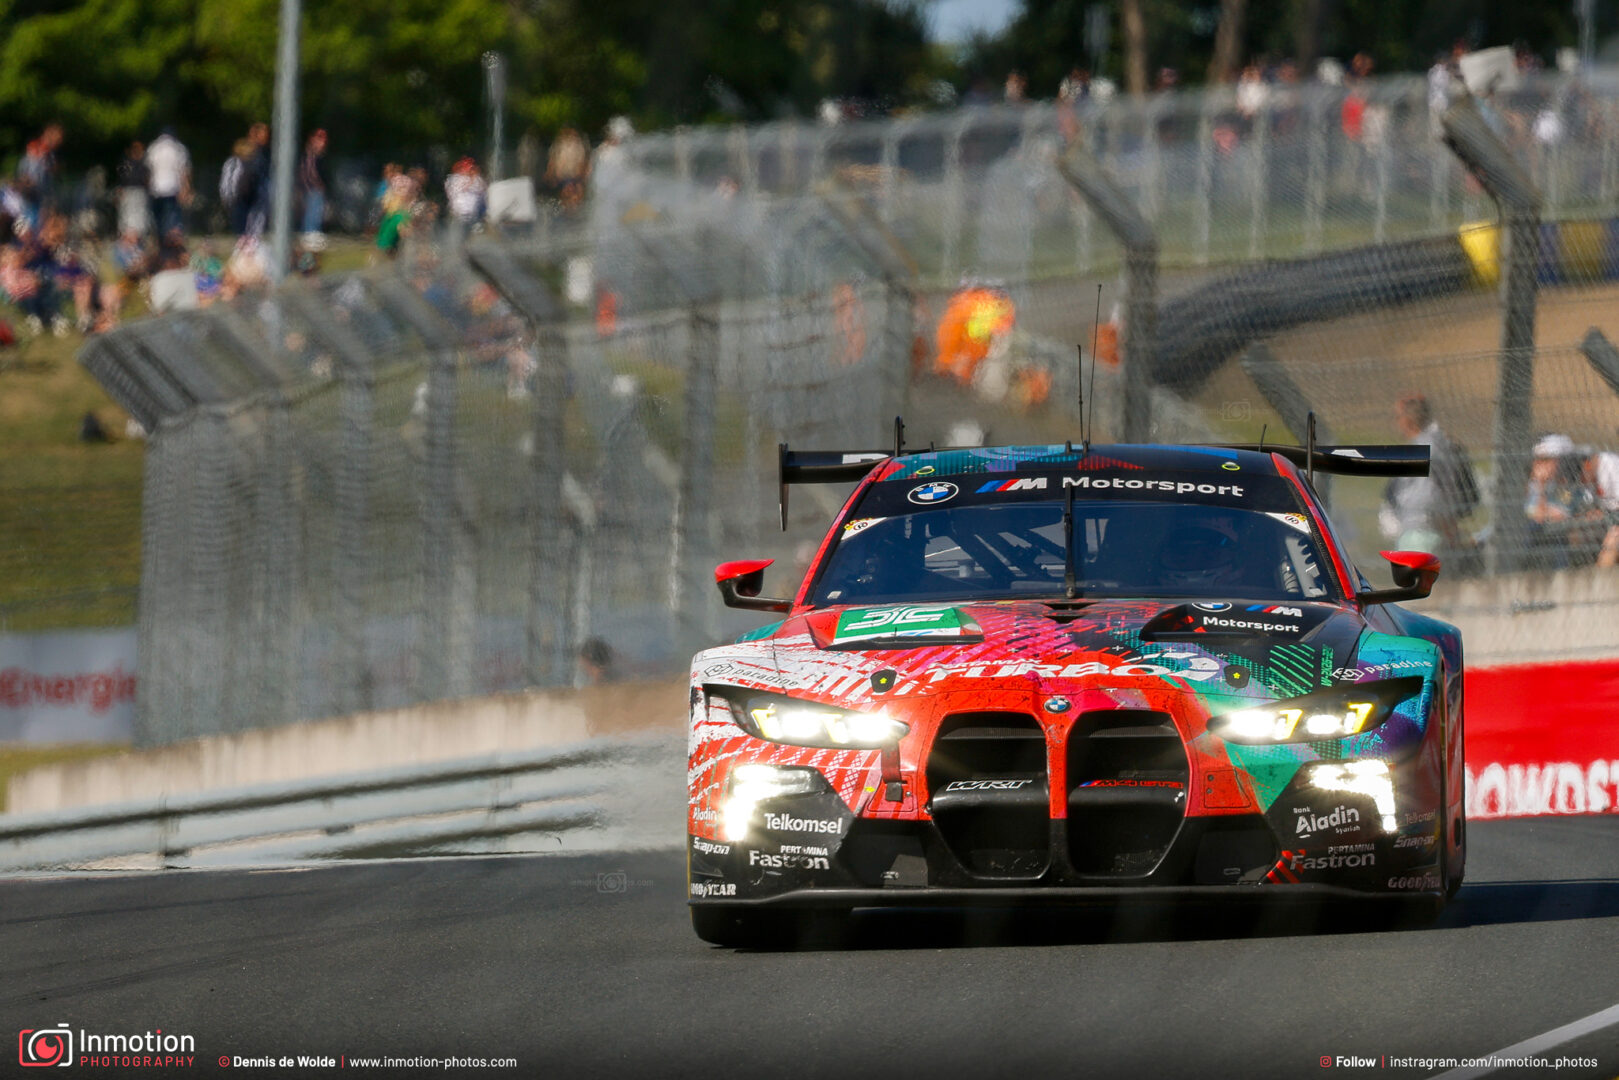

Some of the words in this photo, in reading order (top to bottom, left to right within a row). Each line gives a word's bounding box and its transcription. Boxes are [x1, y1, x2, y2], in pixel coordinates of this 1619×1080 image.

[1062, 476, 1245, 497] Motorsport
[1203, 616, 1299, 632] Motorsport
[924, 661, 1170, 684] TURBO
[1364, 660, 1433, 674] paradine
[734, 668, 799, 687] paradine
[946, 779, 1032, 792] WRT
[1293, 806, 1311, 814] Bank
[764, 813, 843, 834] Telkomsel
[1295, 805, 1360, 834] Aladin
[1328, 842, 1375, 853] PERTAMINA
[1290, 852, 1376, 870] Fastron
